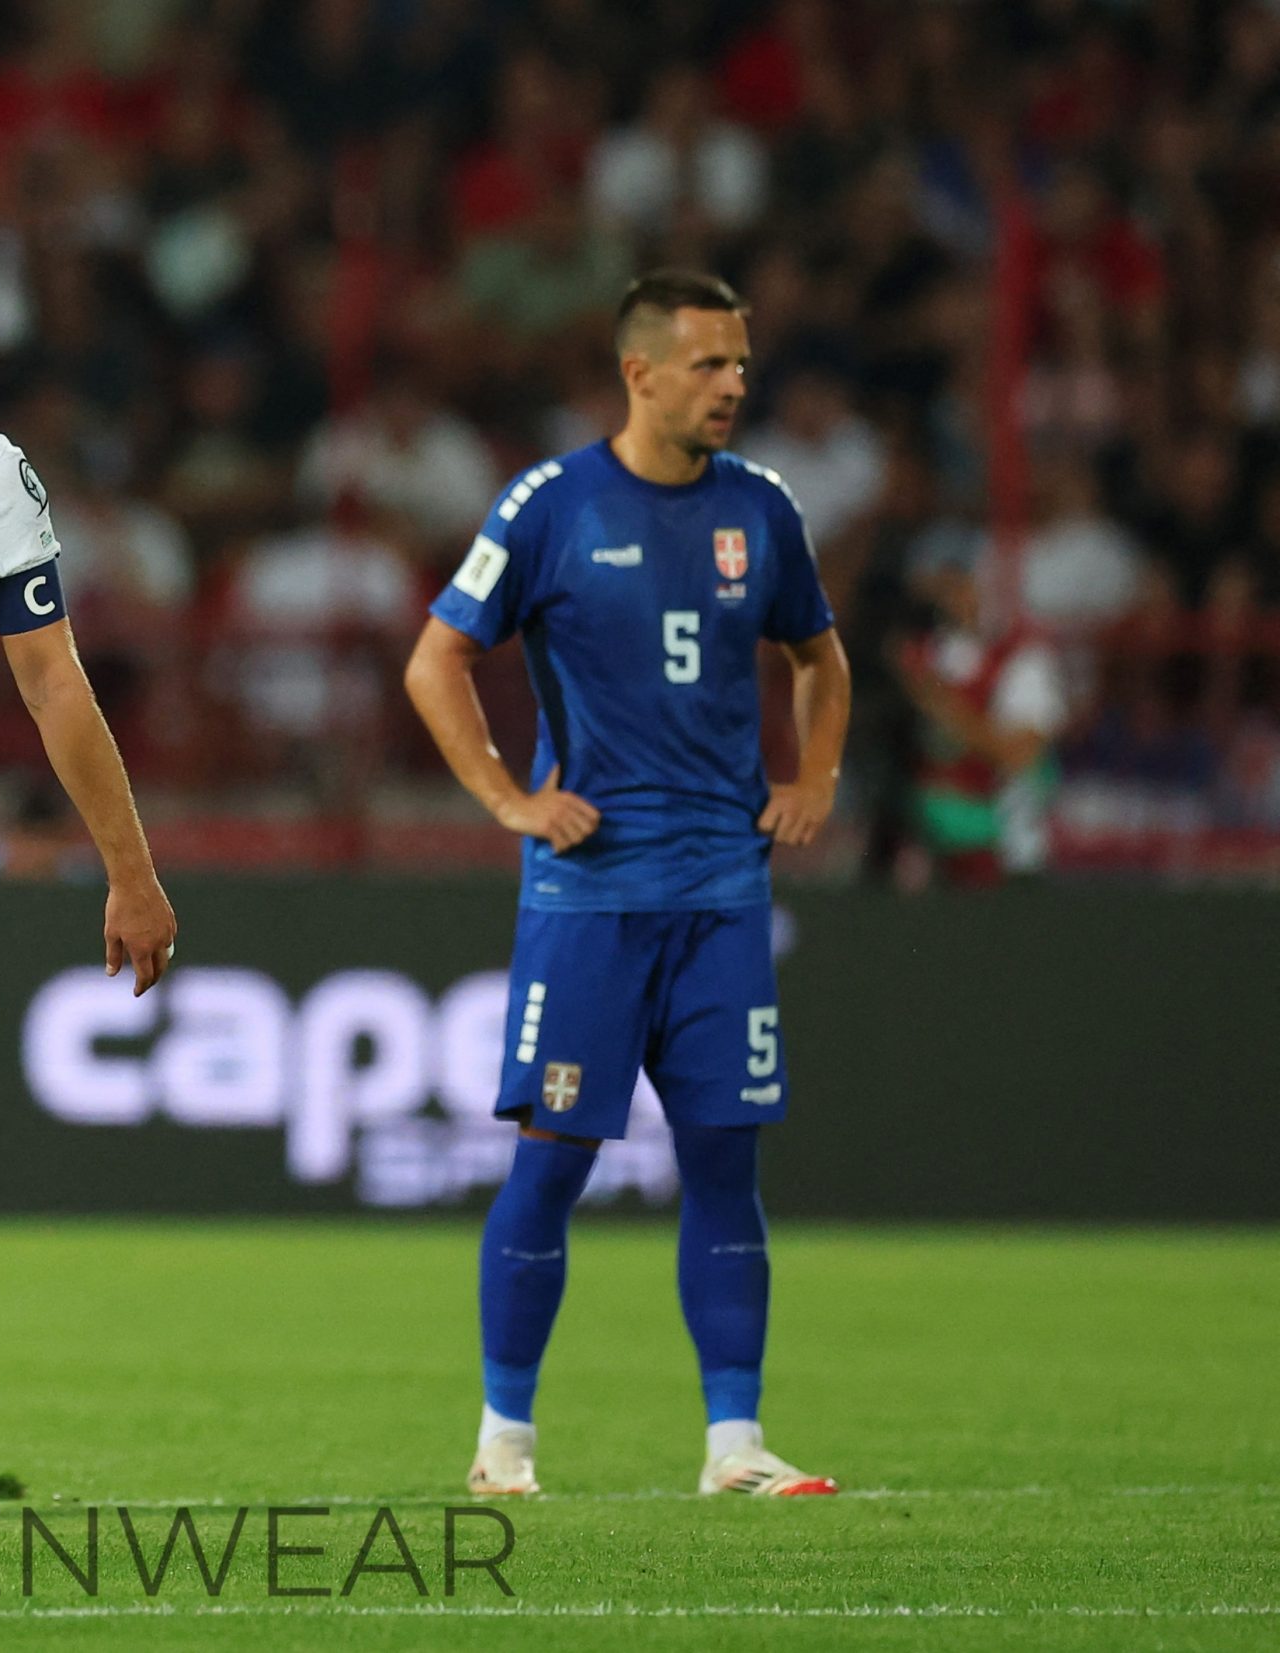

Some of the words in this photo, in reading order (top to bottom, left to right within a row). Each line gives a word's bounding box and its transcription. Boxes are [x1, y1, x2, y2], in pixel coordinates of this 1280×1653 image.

[24, 575, 56, 616] C
[662, 609, 702, 684] 5
[746, 1006, 779, 1078] 5
